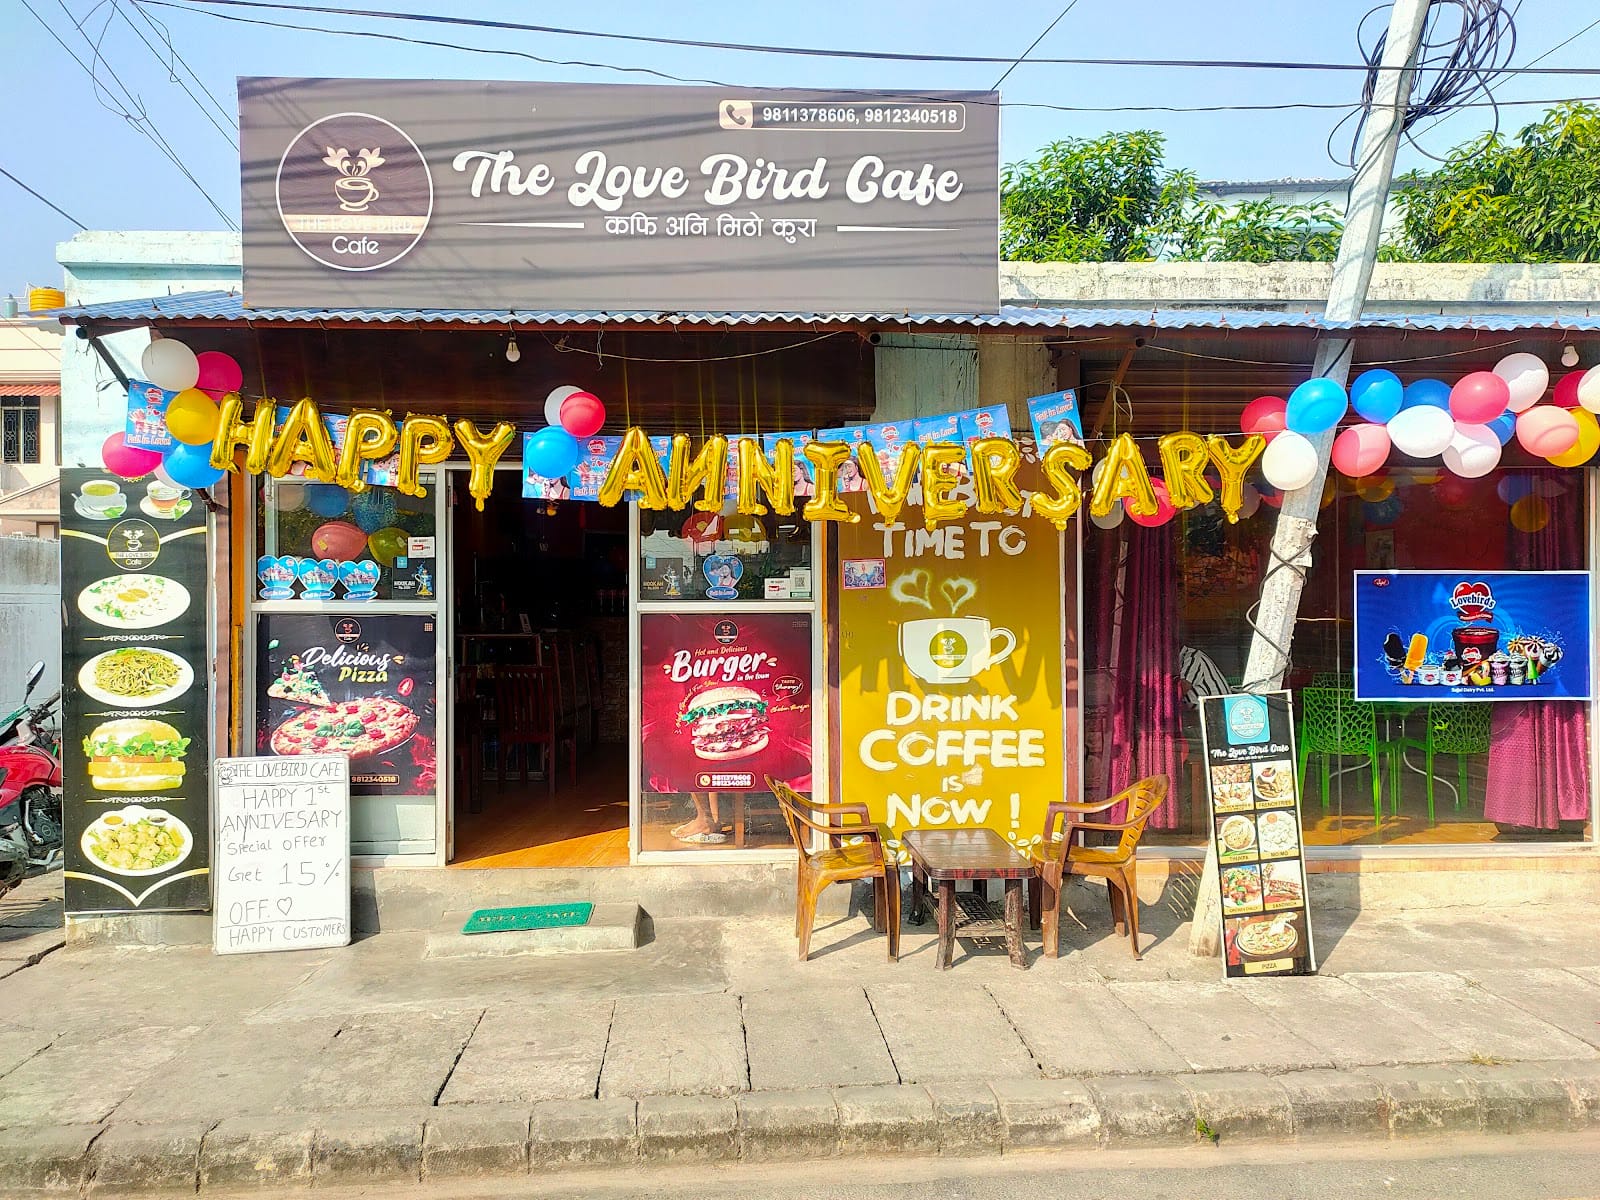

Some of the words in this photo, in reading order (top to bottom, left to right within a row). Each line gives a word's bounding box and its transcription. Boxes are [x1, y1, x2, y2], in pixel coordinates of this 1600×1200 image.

[762, 104, 860, 125] 9811378606,
[864, 106, 958, 125] 9812340518
[452, 150, 555, 198] The
[567, 150, 689, 212] Love
[700, 153, 829, 206] Bird
[845, 155, 963, 206] Cafe
[605, 211, 658, 237] कफि
[665, 213, 707, 237] अनि
[716, 211, 764, 238] मिठो
[771, 217, 818, 244] कुरा
[331, 235, 380, 255] Cafe
[209, 391, 517, 512] HAPPY
[597, 425, 1267, 530] ANNIVERSARY
[873, 521, 965, 560] TIME
[969, 521, 1027, 556] TO
[1449, 592, 1496, 609] Lovebirds
[301, 645, 392, 671] Delicious
[670, 650, 768, 683] Burger
[338, 666, 389, 683] Pizza
[887, 691, 1019, 726] DRINK
[858, 729, 1046, 771] COFFEE
[310, 762, 343, 778] CAFE
[941, 775, 964, 793] IS
[242, 788, 298, 810] HAPPY
[886, 793, 993, 828] NOW
[228, 866, 264, 882] Get
[229, 926, 274, 948] HAPPY
[283, 923, 346, 941] CUSTOMERS
